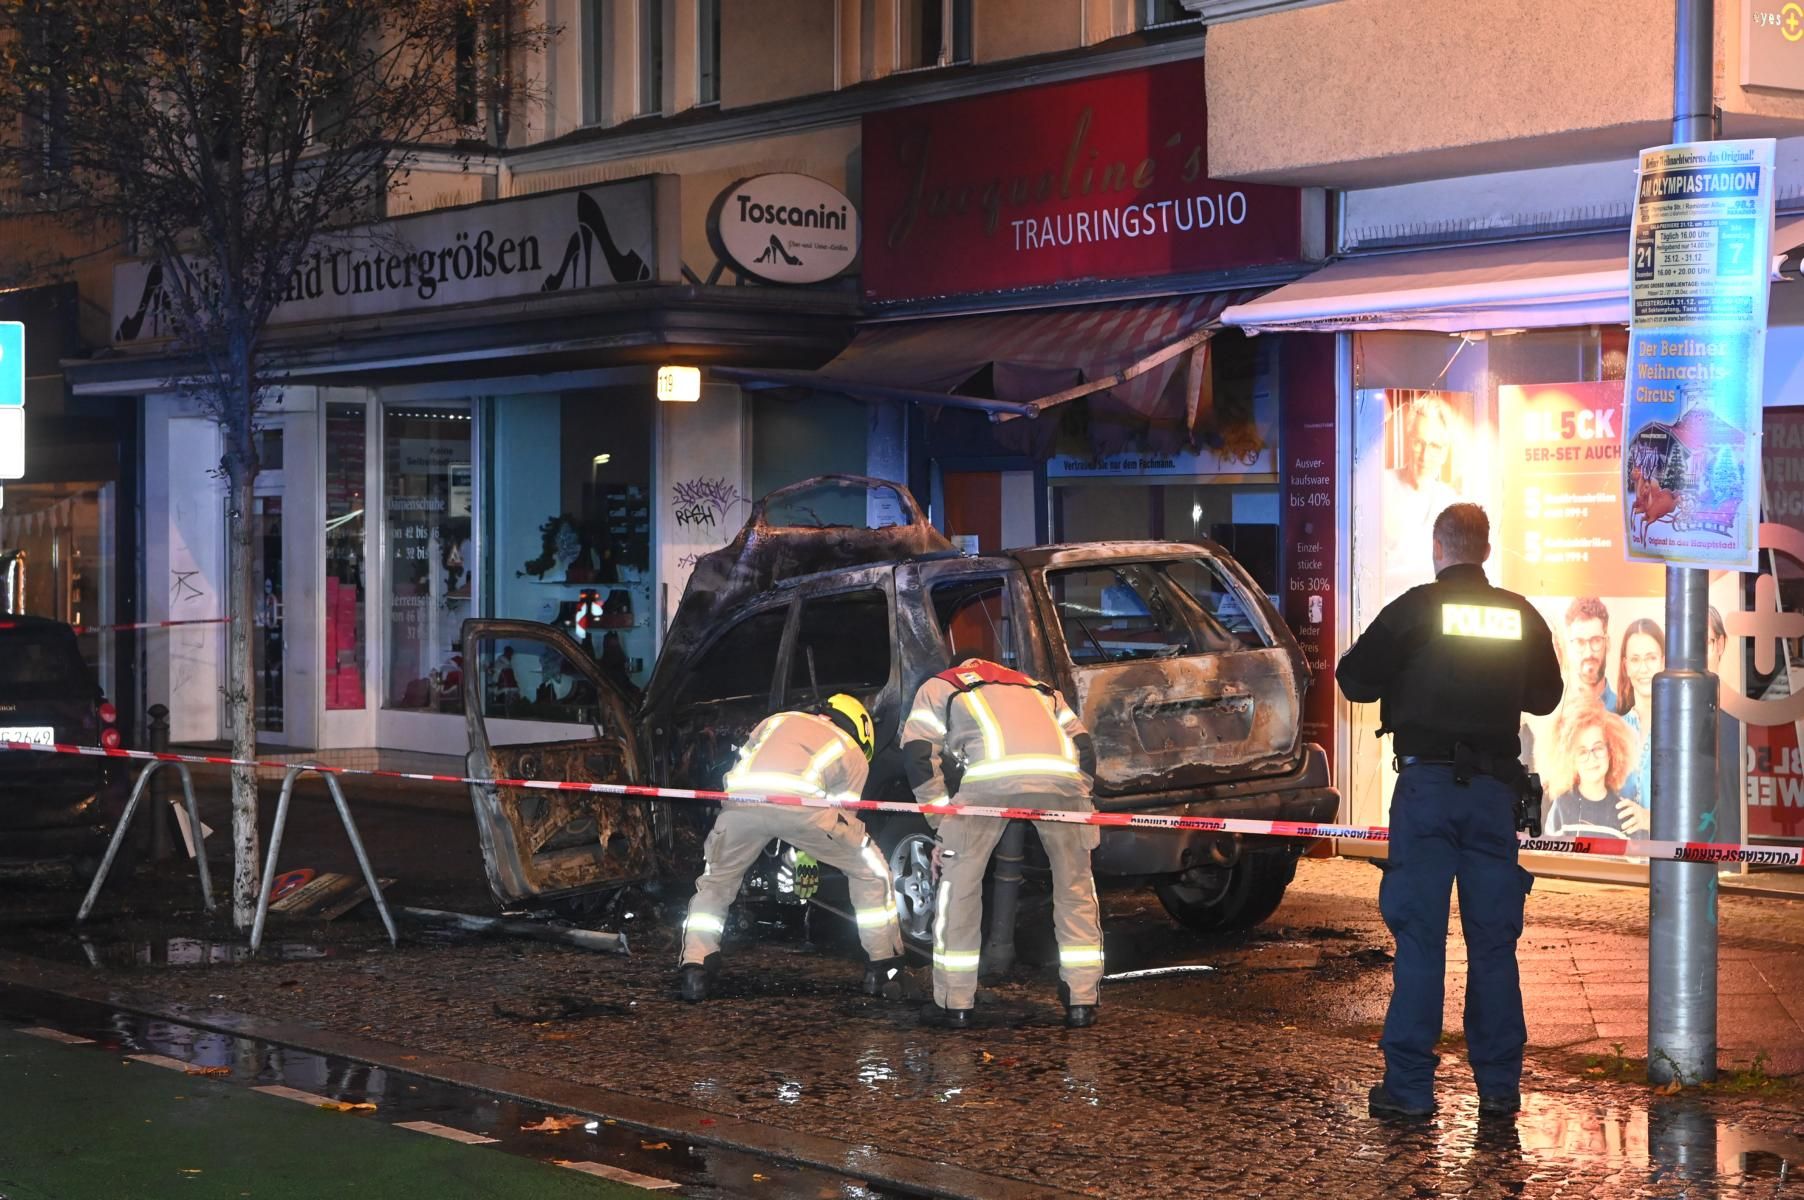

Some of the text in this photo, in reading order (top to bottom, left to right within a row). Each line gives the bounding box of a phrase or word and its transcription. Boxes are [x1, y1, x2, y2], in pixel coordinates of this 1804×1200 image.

[1641, 172, 1757, 198] AM OLYMPIASTADION
[737, 195, 847, 230] Toscanini
[1011, 191, 1248, 251] TRAURINGSTUDIO
[1660, 231, 1679, 241] Täglich
[1681, 231, 1696, 239] 16.00
[1697, 230, 1710, 238] Uhr
[1637, 246, 1652, 268] 21
[1728, 243, 1744, 264] 7
[324, 230, 542, 300] Untergrößen
[1678, 267, 1696, 275] 20.00
[1639, 338, 1728, 357] Der Berliner
[1637, 362, 1730, 380] Weihnachts-
[1636, 386, 1676, 403] Circus
[1525, 445, 1622, 462] 5ER-SET AUCH
[1109, 461, 1121, 470] nur
[1123, 459, 1137, 469] dem
[1295, 458, 1325, 469] Ausver-
[1290, 475, 1330, 486] kaufsware
[1290, 492, 1331, 507] bis 40%
[1297, 542, 1323, 553] Einzel-
[1691, 538, 1737, 550] Hauptstadt
[1297, 559, 1322, 570] stücke
[1290, 577, 1330, 591] bis 30%
[1444, 605, 1521, 637] POLIZEI
[1674, 847, 1799, 865] POLIZEIABSPERRUNG
